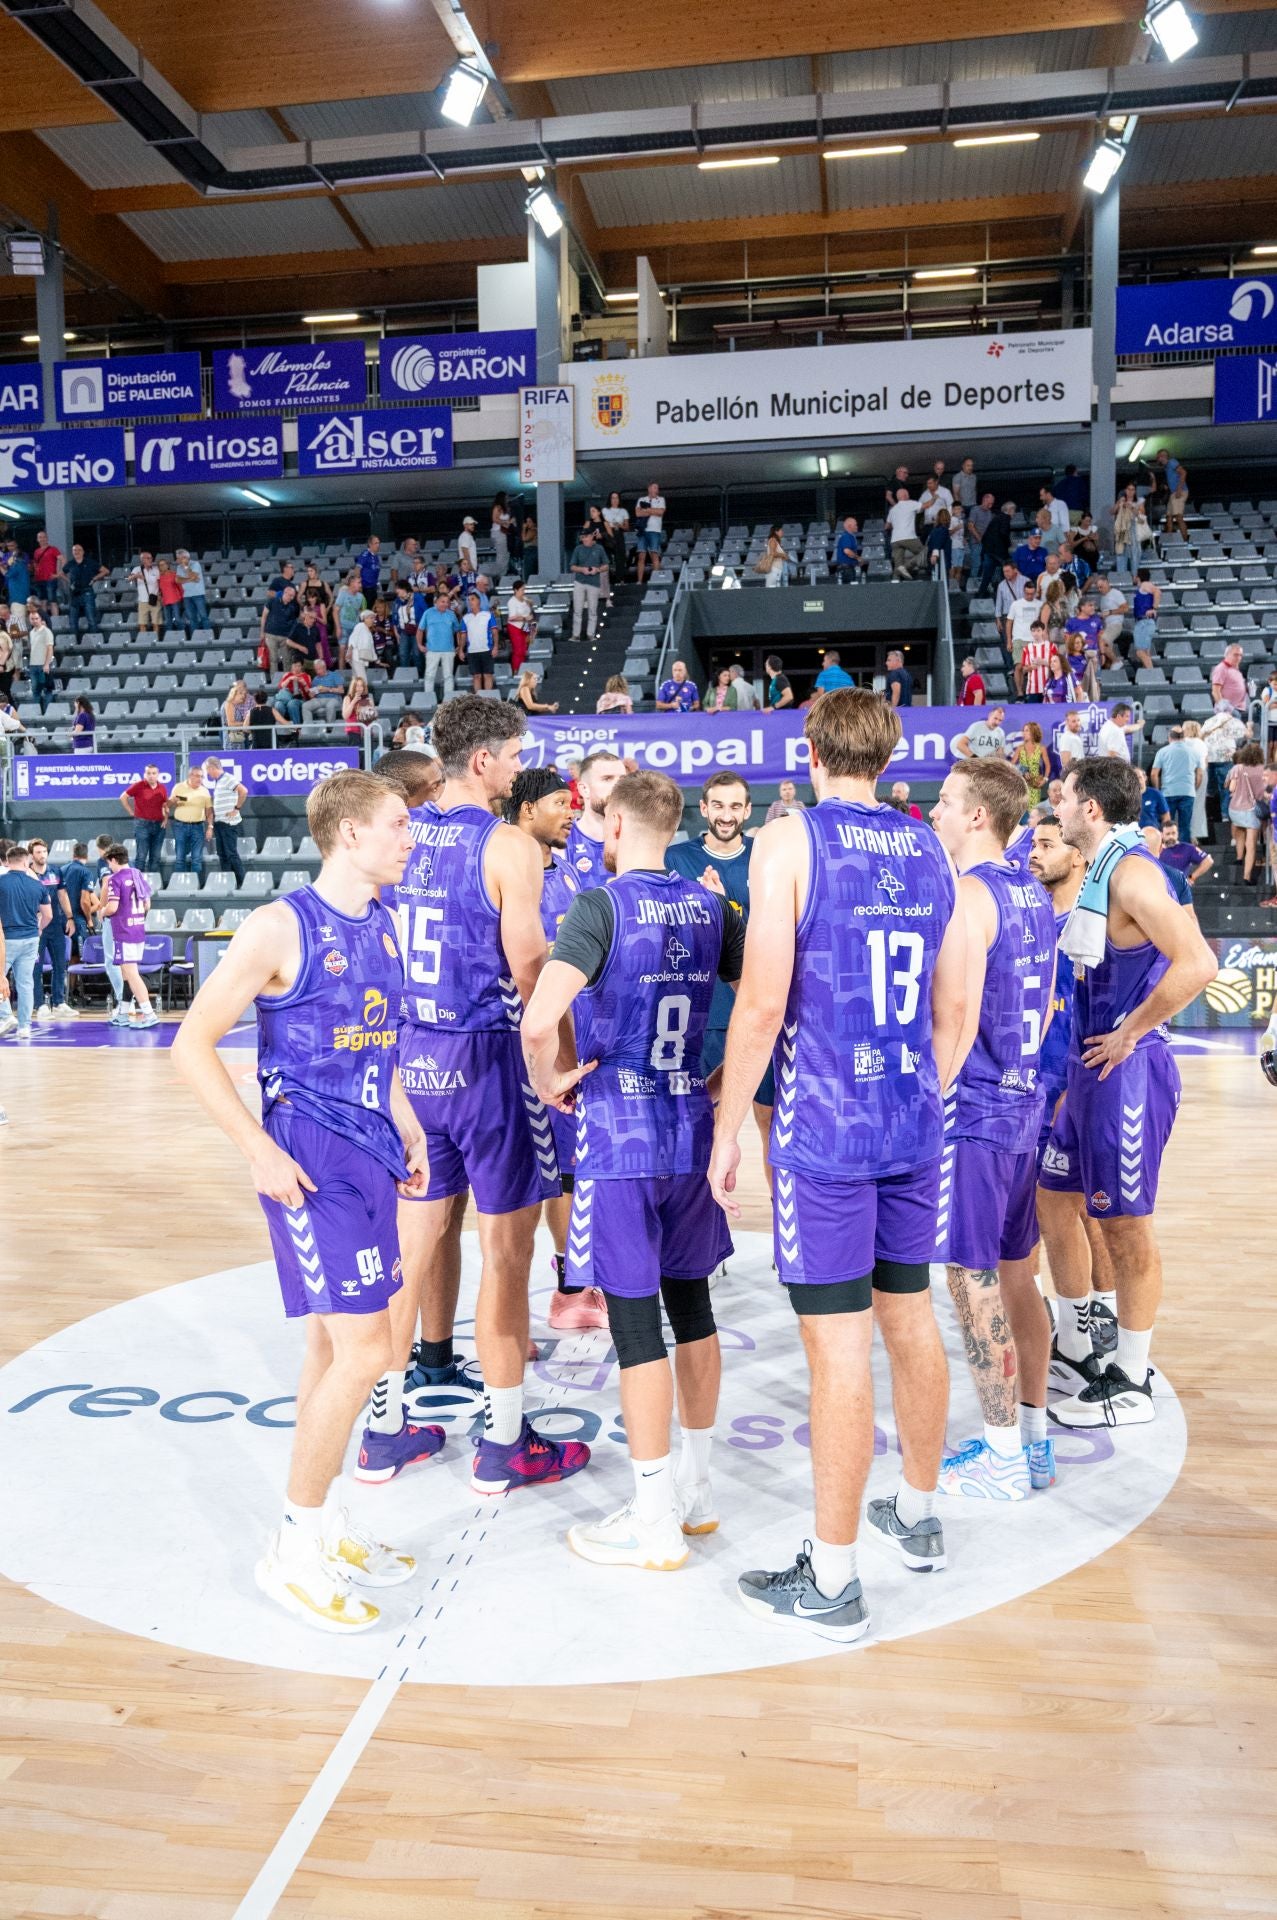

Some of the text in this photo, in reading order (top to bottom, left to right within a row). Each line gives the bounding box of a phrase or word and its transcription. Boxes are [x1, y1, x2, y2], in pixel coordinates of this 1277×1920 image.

[1145, 322, 1234, 347] Adarsa
[438, 346, 486, 359] carpintería
[250, 350, 331, 376] Mármoles
[107, 370, 176, 387] Diputación
[284, 371, 350, 395] Palencia
[108, 386, 194, 403] DE PALENCIA
[239, 395, 340, 408] SOMOS FABRICANTES
[524, 388, 570, 405] RIFA
[656, 379, 1065, 424] Pabellón Municipal de Deportes
[324, 416, 444, 461] alser
[187, 435, 278, 461] nirosa
[362, 456, 438, 468] INSTALACIONES
[554, 727, 618, 744] súper
[35, 772, 172, 786] Pastor SUAO
[836, 823, 922, 857] VRANKIĆ
[904, 902, 932, 917] salud
[398, 903, 444, 985] 15
[687, 969, 710, 982] salud
[866, 929, 924, 1027] 13
[438, 1008, 456, 1021] Dip
[333, 1025, 364, 1034] súper
[650, 994, 691, 1071] 8
[872, 1048, 881, 1057] PA
[872, 1055, 885, 1065] LEN
[873, 1064, 884, 1073] CIA
[361, 1065, 380, 1109] 6
